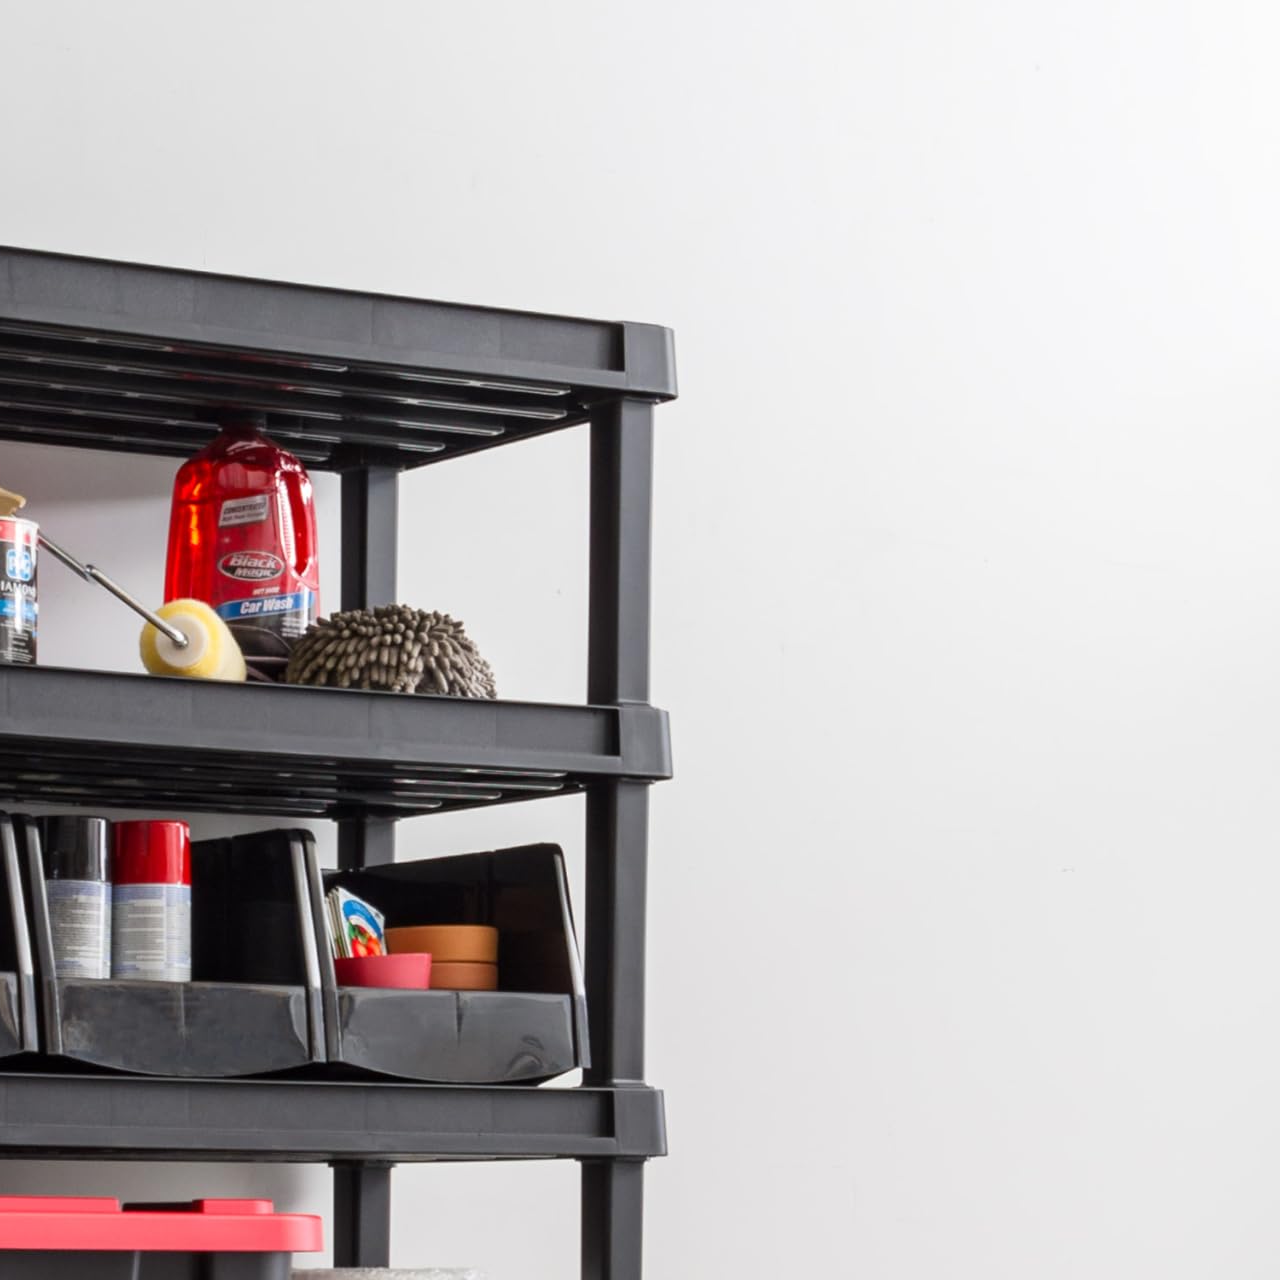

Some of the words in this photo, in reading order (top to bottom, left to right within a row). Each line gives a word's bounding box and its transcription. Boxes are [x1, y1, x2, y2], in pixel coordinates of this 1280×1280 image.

[229, 554, 277, 569] Black
[240, 601, 262, 614] Car
[263, 597, 294, 611] Wash
